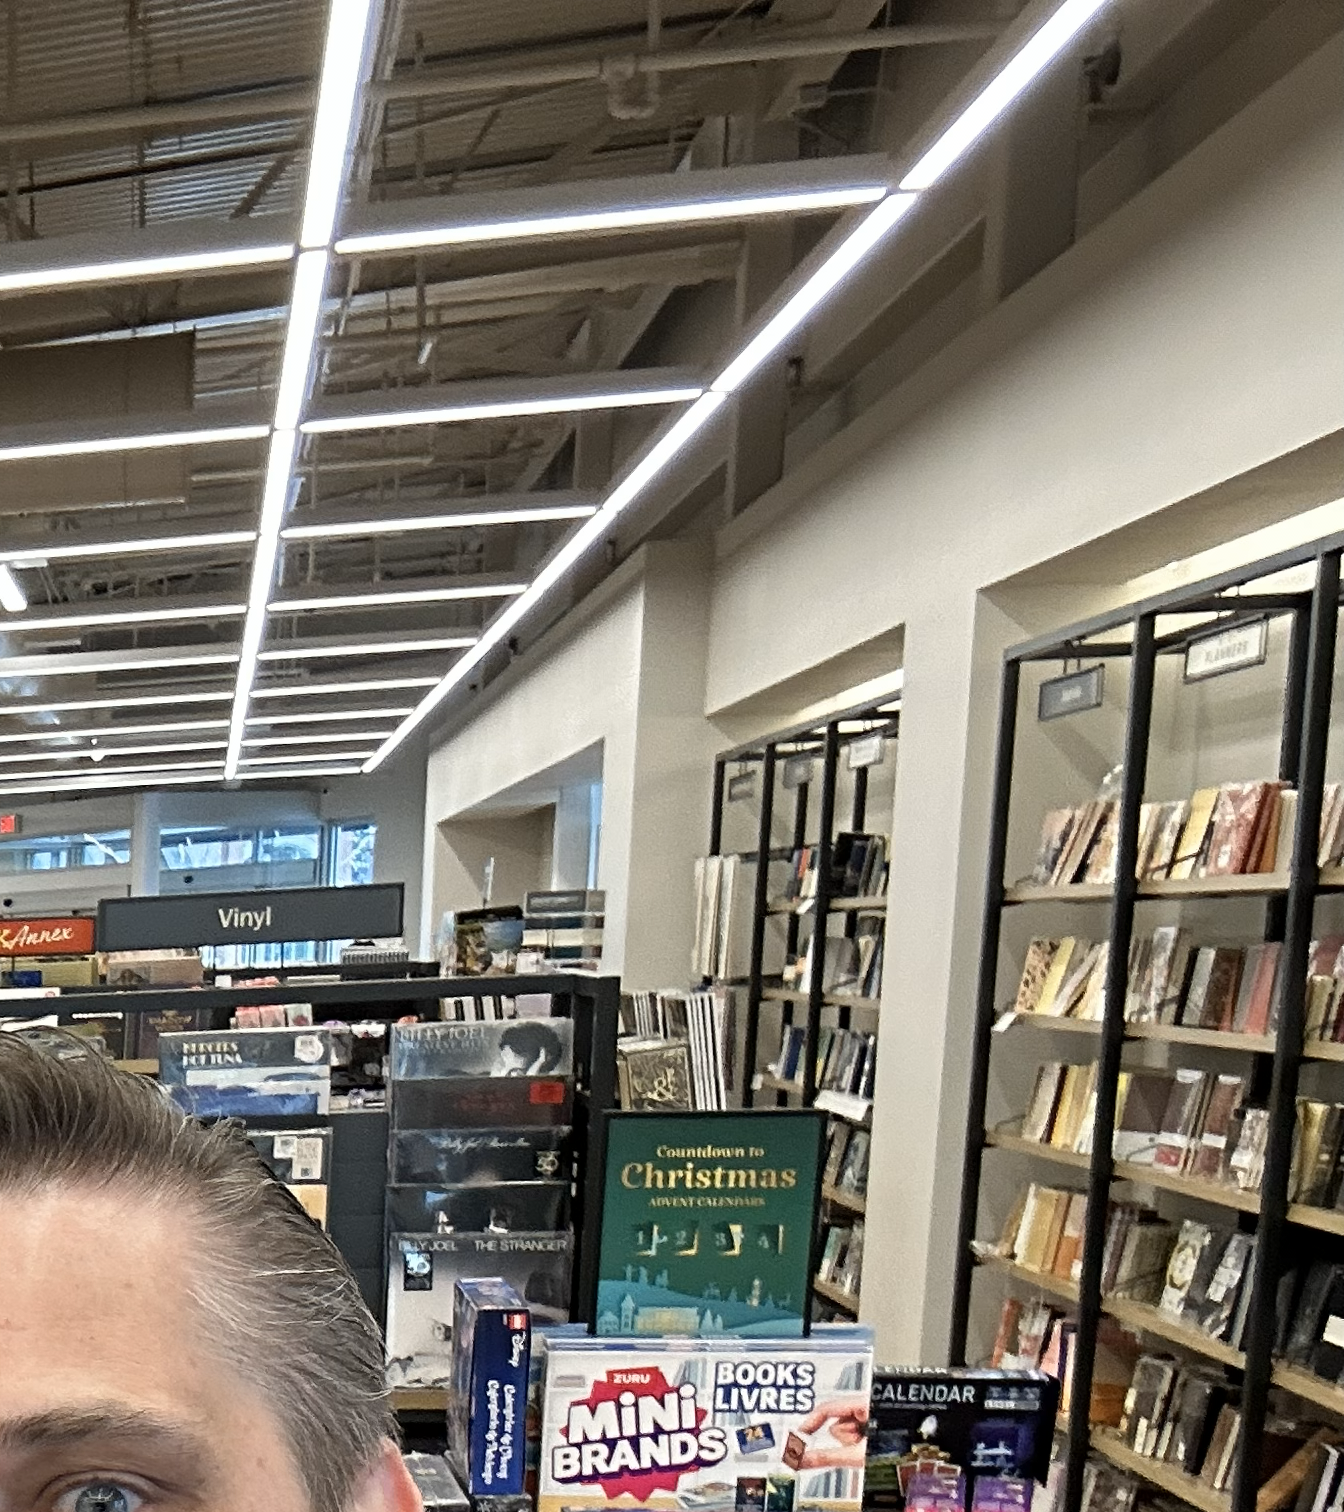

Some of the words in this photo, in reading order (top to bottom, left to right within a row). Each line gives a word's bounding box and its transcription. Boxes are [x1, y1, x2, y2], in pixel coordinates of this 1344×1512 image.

[217, 906, 271, 931] Vinyl
[7, 925, 73, 949] Annex
[657, 1145, 745, 1158] Countdown
[749, 1146, 764, 1158] to
[621, 1162, 797, 1190] Christmas
[613, 1372, 650, 1385] ZURU
[716, 1361, 814, 1387] BOOKS
[715, 1386, 814, 1413] LIVRES
[871, 1384, 976, 1403] CALENDAR
[568, 1383, 698, 1445] MiNi
[552, 1427, 728, 1483] BRANDS
